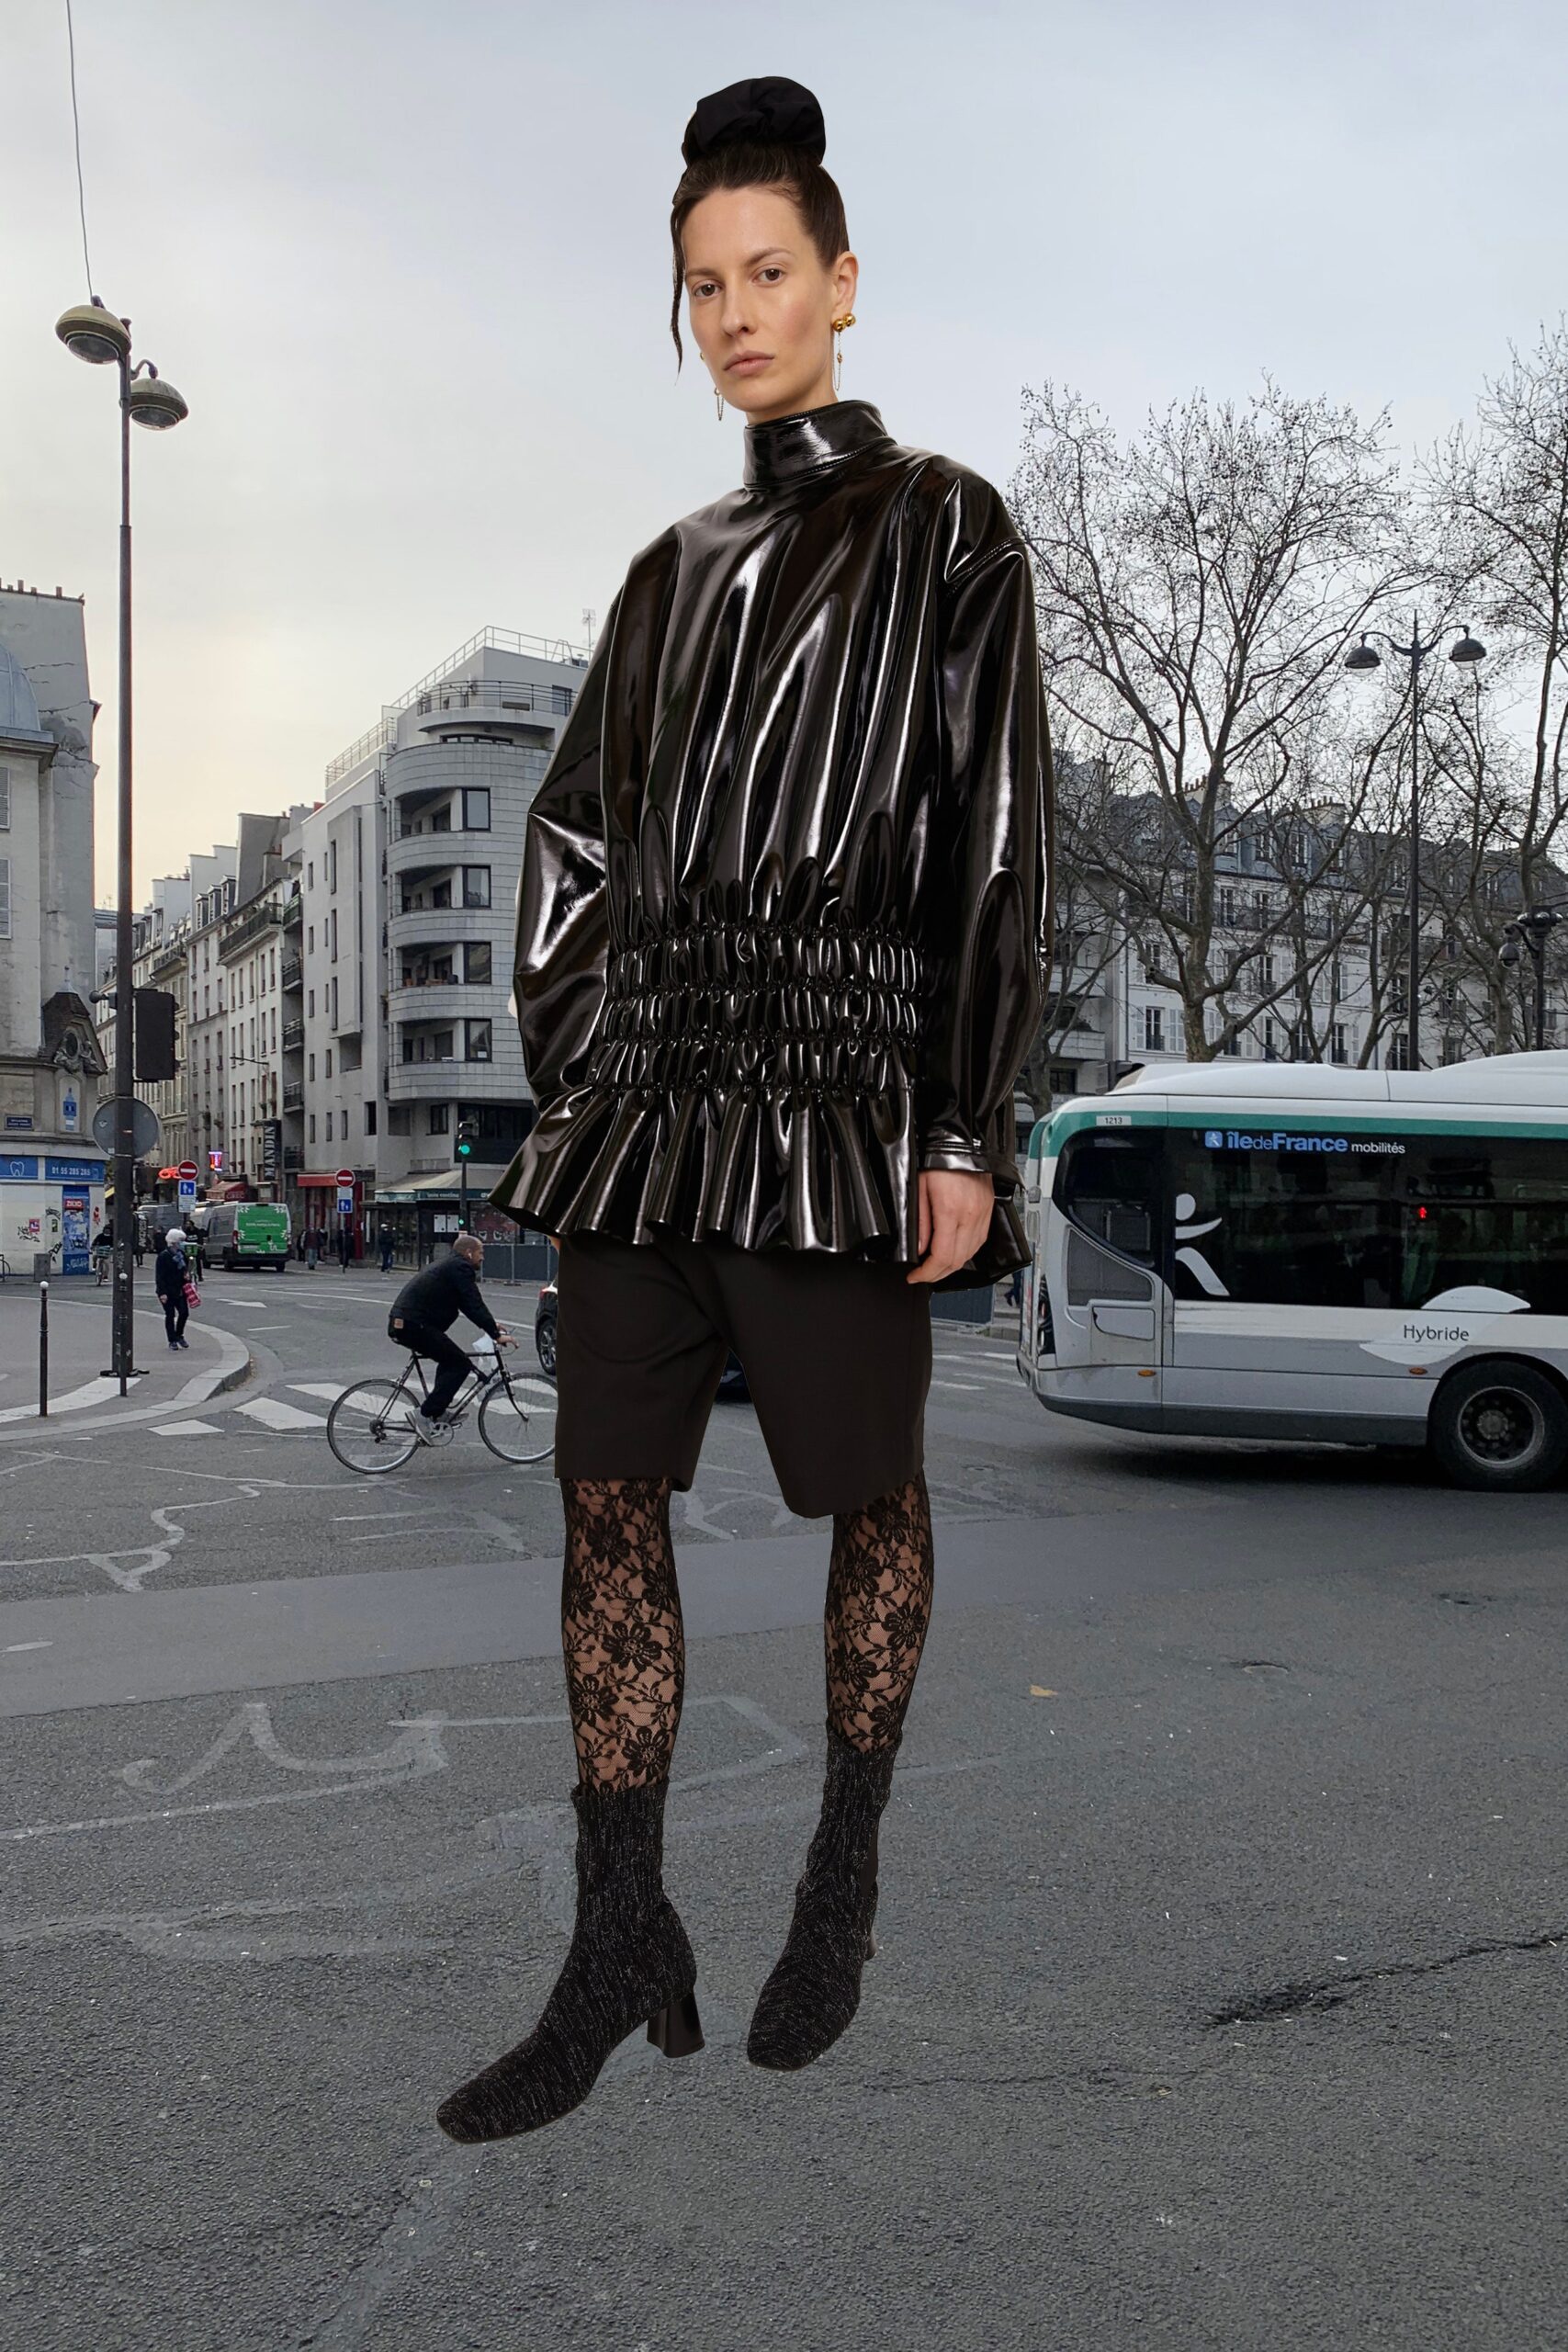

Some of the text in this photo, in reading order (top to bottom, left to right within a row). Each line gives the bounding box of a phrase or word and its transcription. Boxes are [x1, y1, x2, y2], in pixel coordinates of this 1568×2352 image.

[1105, 1116, 1122, 1125] 1213
[265, 1125, 276, 1177] MANDIN
[1351, 1141, 1405, 1154] mobilités
[1404, 1325, 1470, 1343] Hybride
